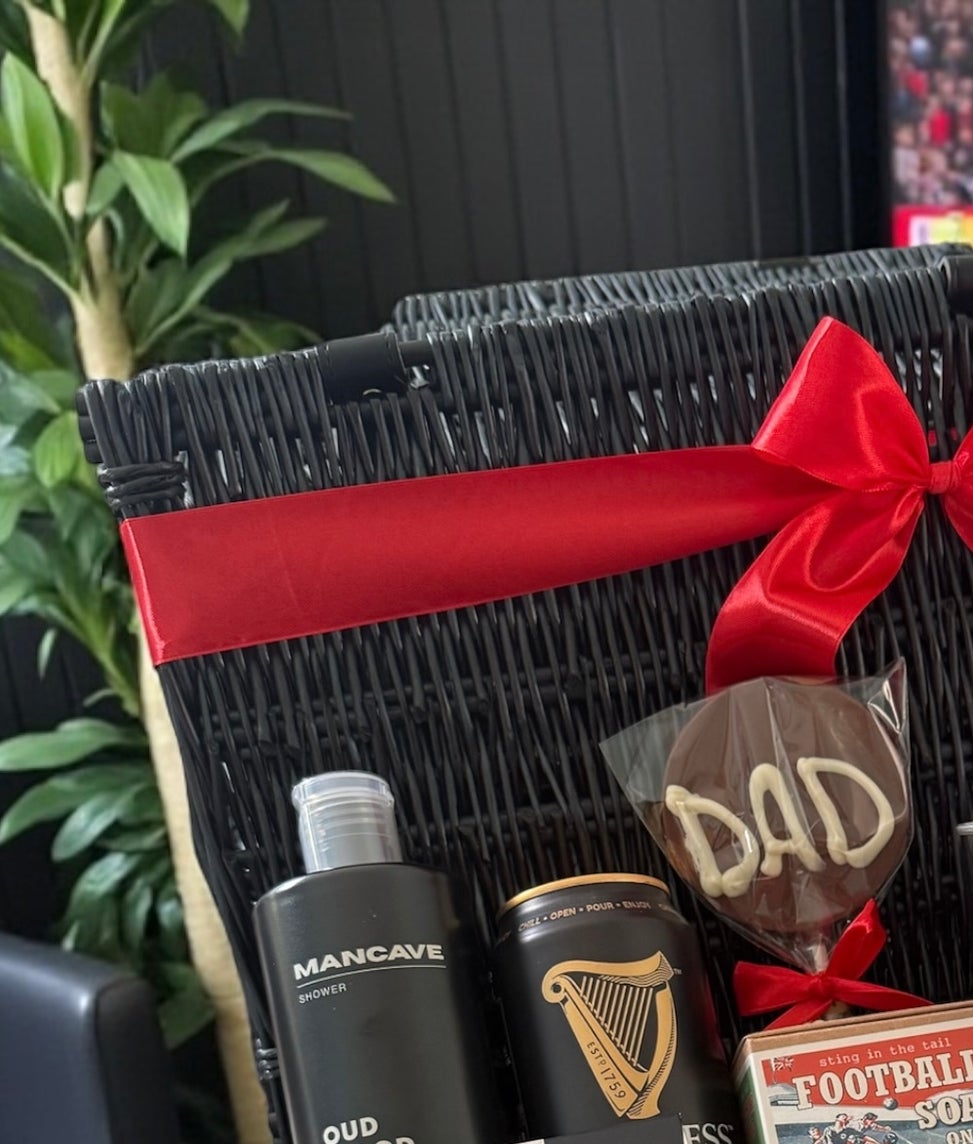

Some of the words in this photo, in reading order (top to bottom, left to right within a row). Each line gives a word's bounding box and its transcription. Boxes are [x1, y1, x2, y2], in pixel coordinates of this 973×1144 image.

[665, 757, 895, 897] DAD
[518, 916, 541, 932] CHILL
[550, 907, 576, 920] OPEN
[586, 902, 614, 912] POUR
[622, 901, 652, 910] ENJOY
[293, 944, 444, 980] MANCAVE
[299, 983, 347, 1004] SHOWER
[819, 1053, 860, 1067] sting
[867, 1049, 882, 1059] in
[890, 1042, 915, 1056] the
[922, 1038, 951, 1051] tail
[600, 1068, 627, 1098] 1759
